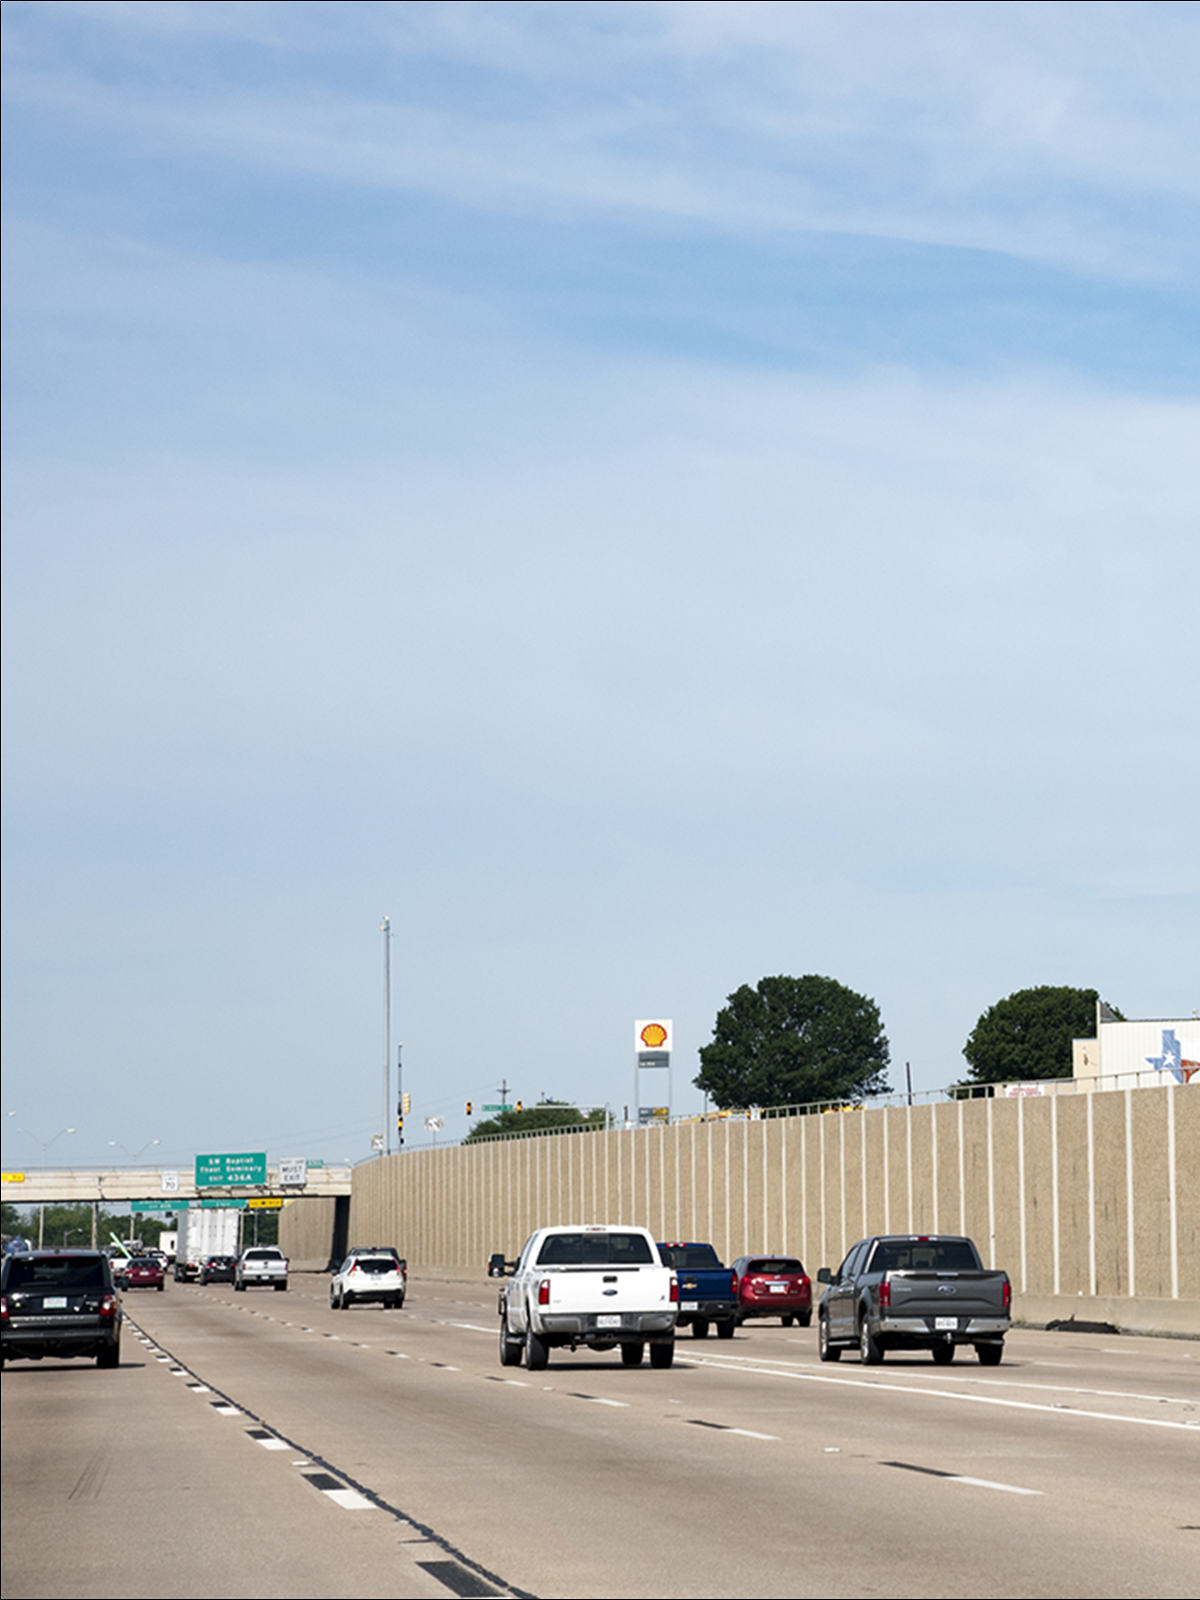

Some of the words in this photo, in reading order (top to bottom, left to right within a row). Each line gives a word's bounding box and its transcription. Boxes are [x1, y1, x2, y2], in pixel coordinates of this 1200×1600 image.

[226, 1157, 254, 1166] Baptist
[226, 1165, 262, 1174] Seminary
[165, 1181, 176, 1189] 70
